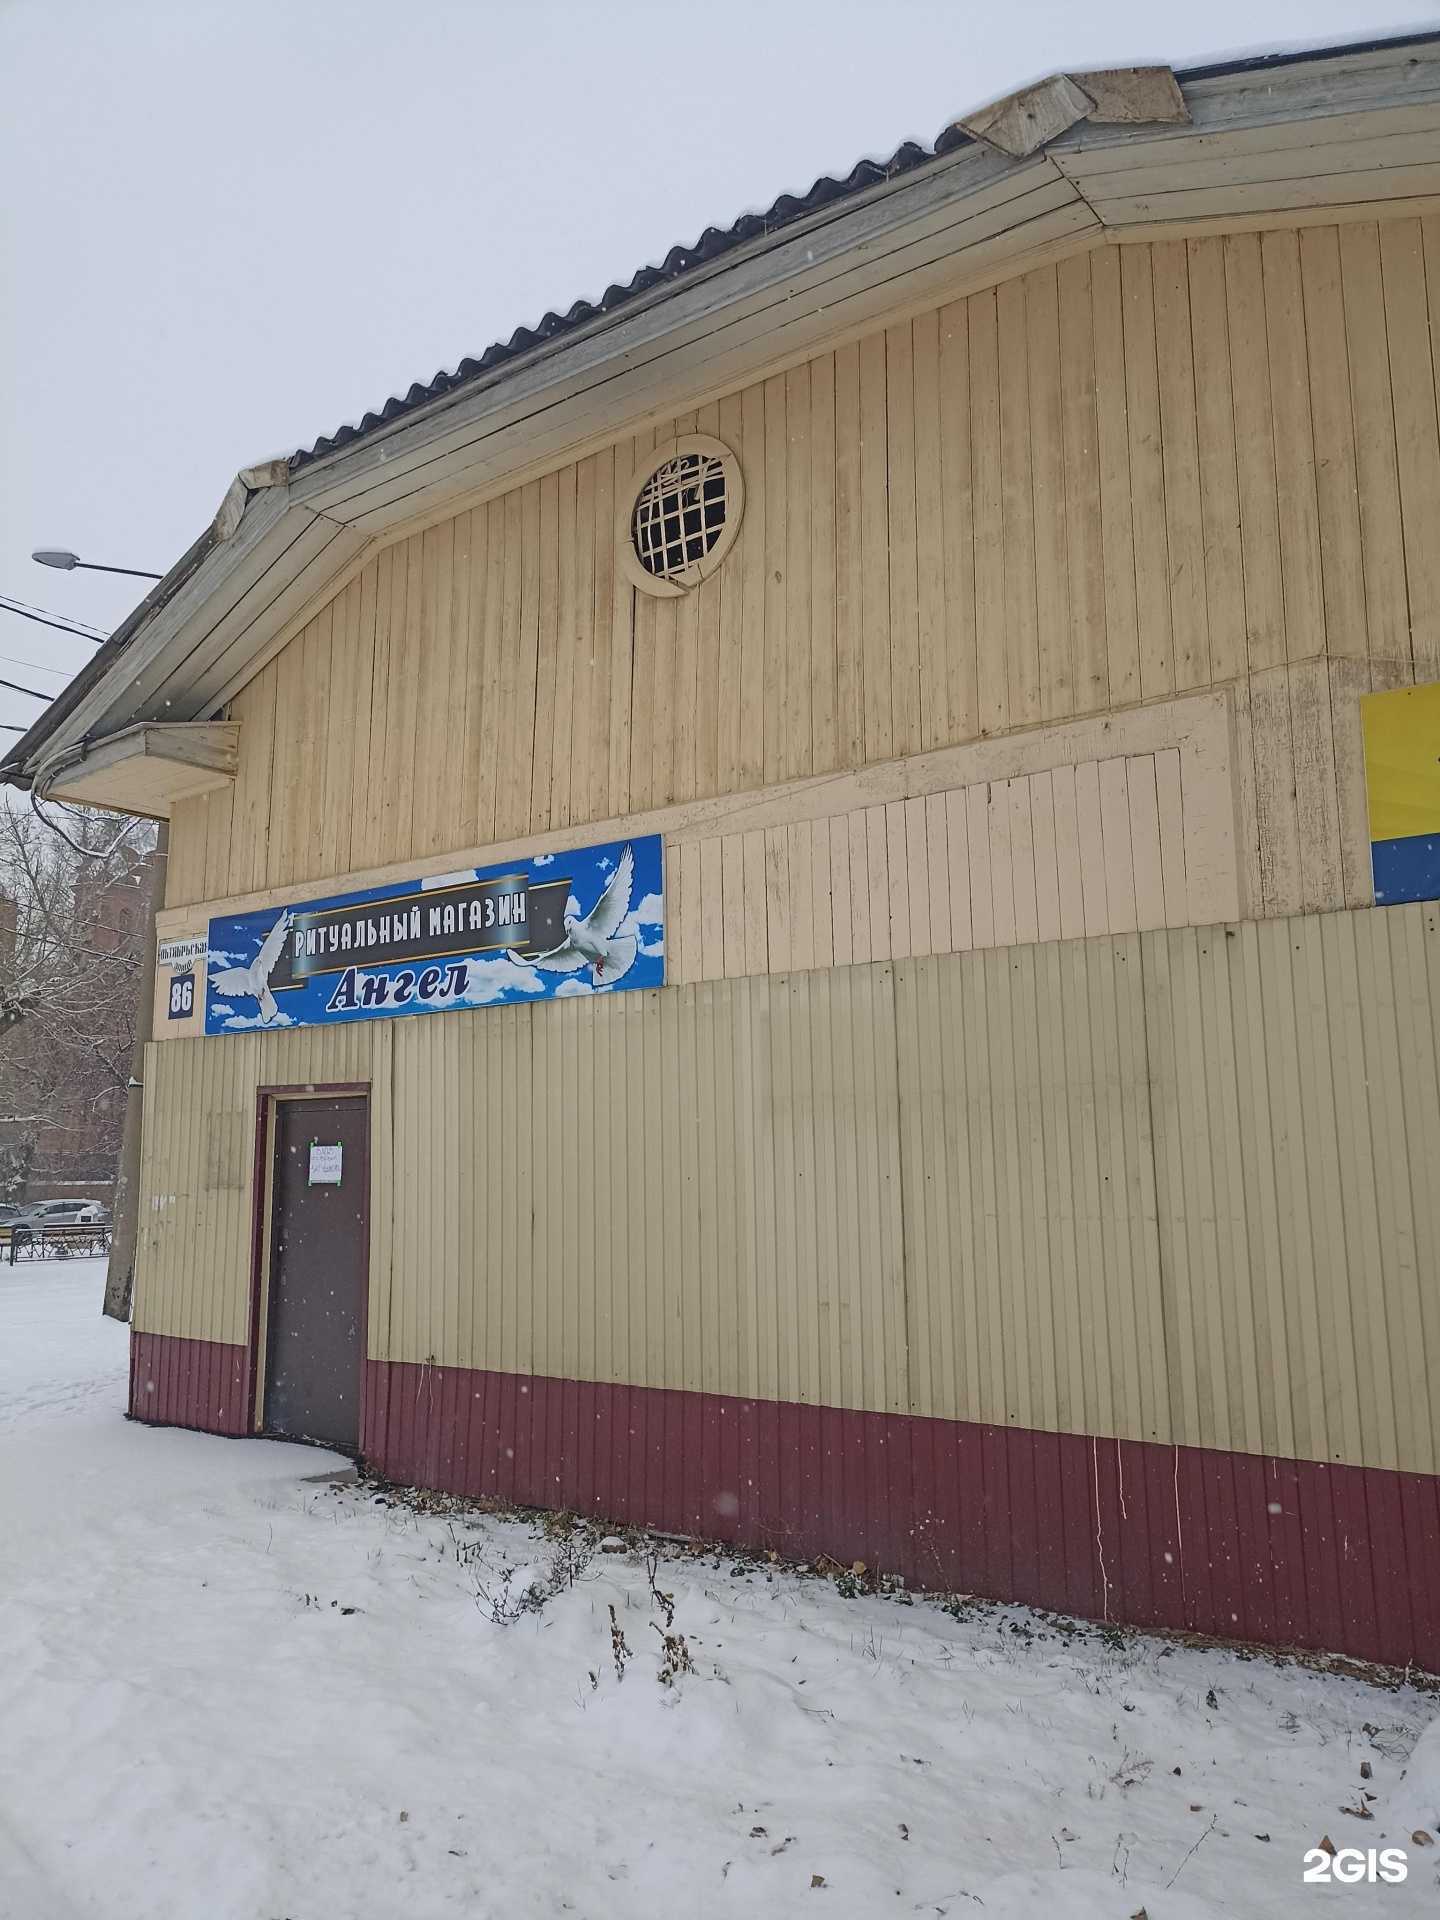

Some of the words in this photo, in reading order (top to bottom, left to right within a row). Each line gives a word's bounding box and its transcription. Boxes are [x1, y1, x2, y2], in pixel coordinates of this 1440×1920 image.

[295, 906, 421, 957] РИТУАЛЬНЫЙ
[429, 892, 527, 936] МАГАЗИН
[170, 981, 193, 1013] 86
[326, 965, 470, 1013] Ангел
